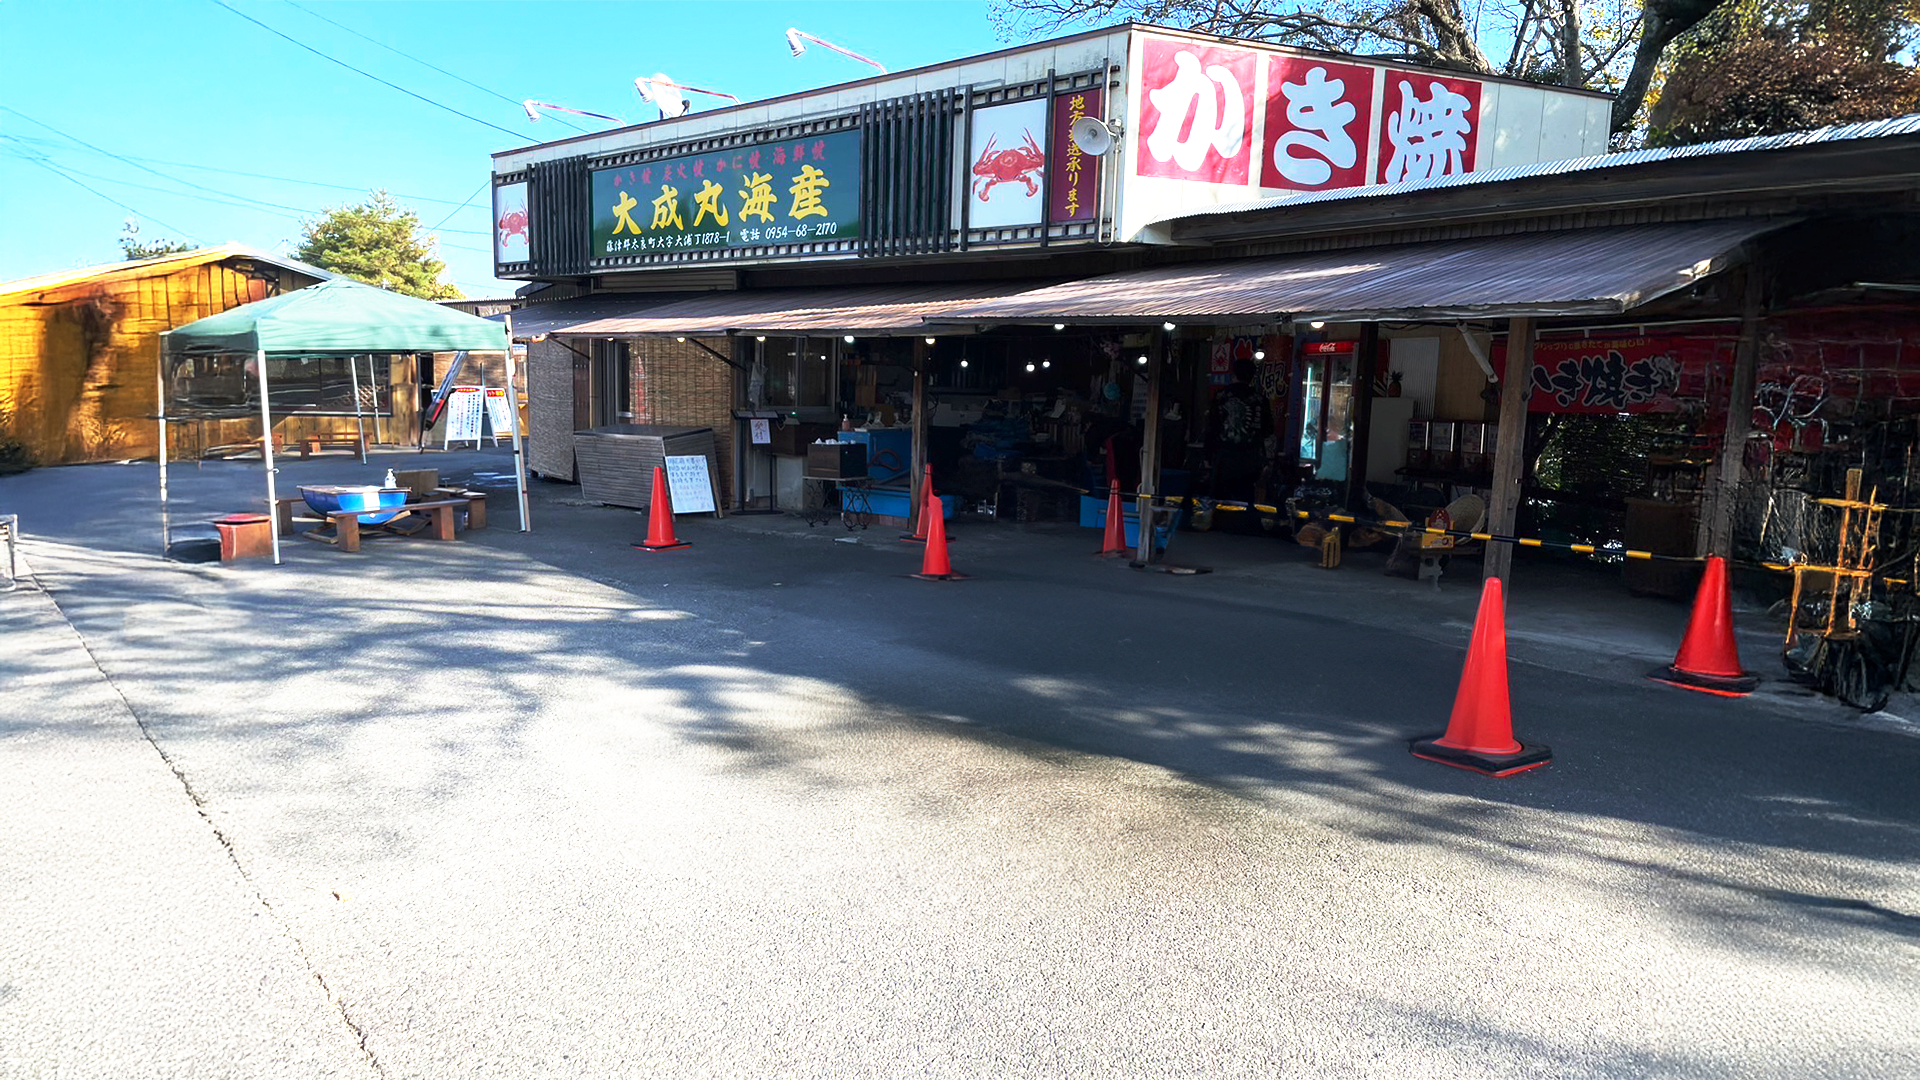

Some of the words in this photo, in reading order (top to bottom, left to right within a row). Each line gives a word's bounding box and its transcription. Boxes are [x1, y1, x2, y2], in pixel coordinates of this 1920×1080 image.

[1065, 95, 1086, 218] 地方送承ります
[611, 164, 830, 236] 大成丸海産
[740, 228, 760, 243] 電話
[765, 222, 837, 240] 0954-68-2170
